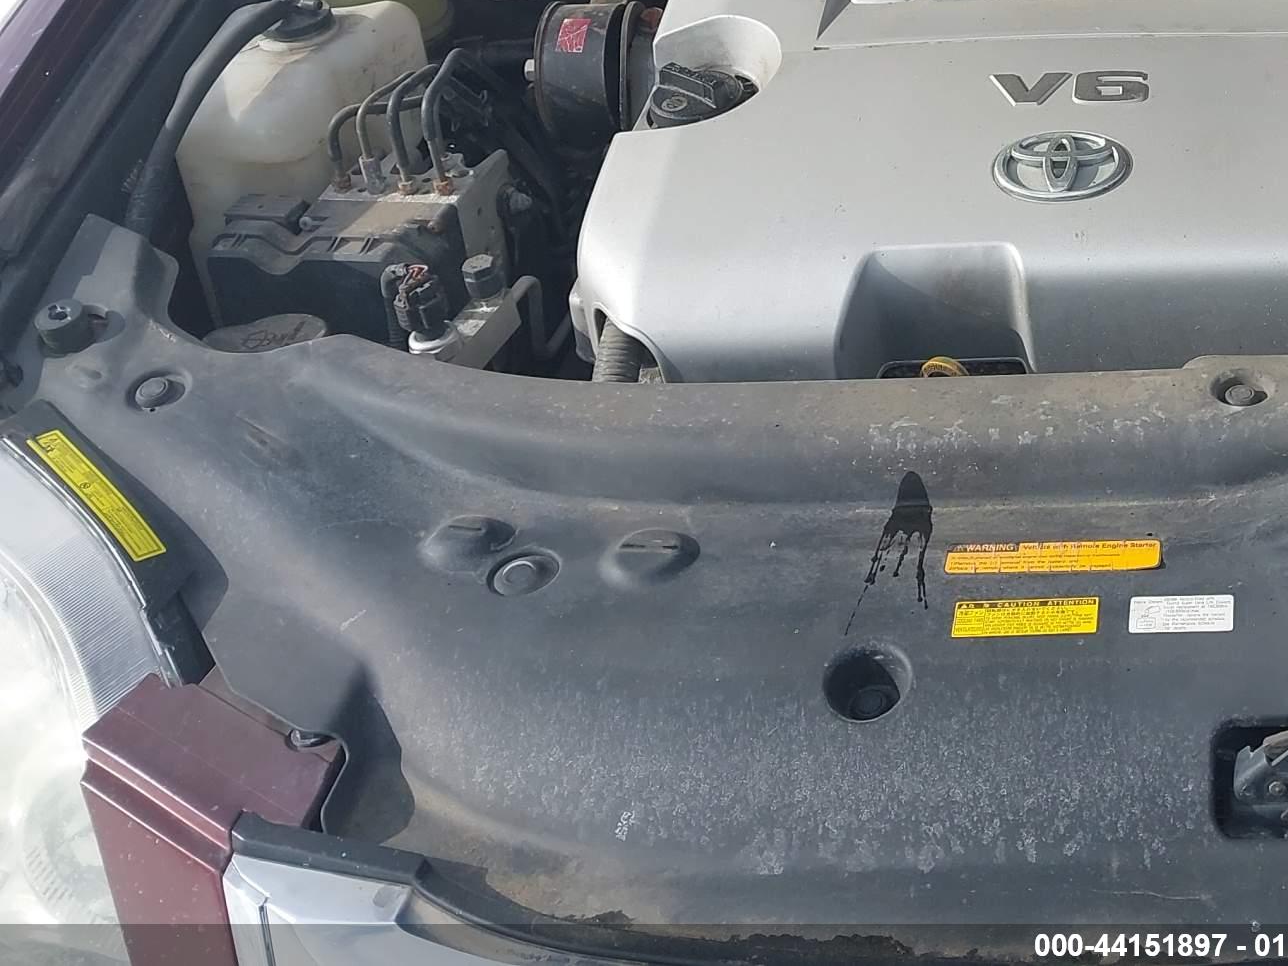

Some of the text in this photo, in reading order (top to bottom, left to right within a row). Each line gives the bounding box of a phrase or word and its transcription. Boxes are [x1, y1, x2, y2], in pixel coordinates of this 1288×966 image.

[989, 70, 1150, 107] V6
[966, 543, 1015, 552] WARNING
[1102, 542, 1128, 551] Engine
[1130, 540, 1157, 548] Starter
